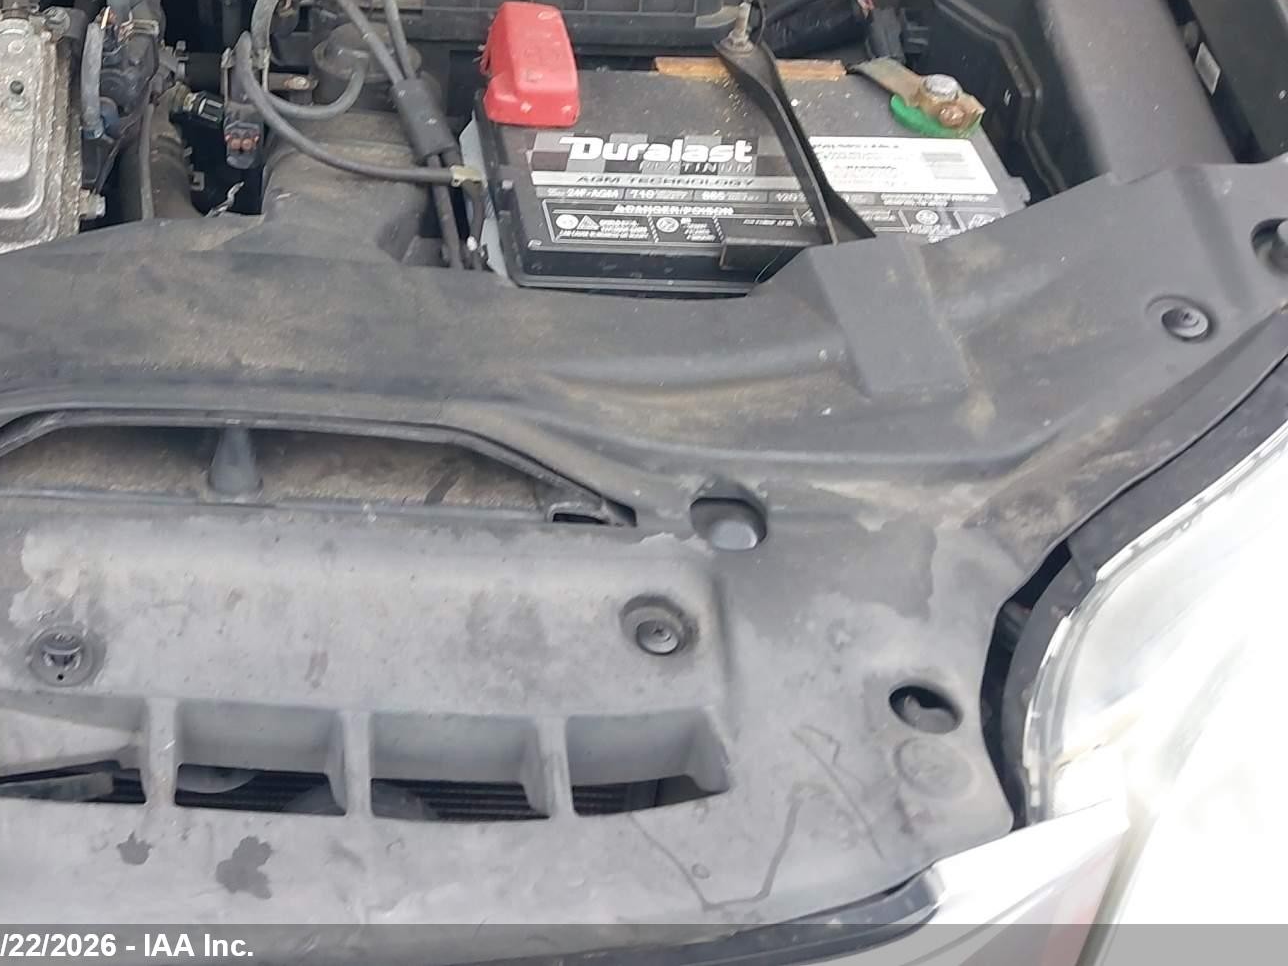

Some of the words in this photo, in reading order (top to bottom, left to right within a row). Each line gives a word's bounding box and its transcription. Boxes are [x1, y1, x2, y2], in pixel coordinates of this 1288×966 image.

[559, 136, 753, 163] Duralast
[638, 161, 754, 173] PLATINUM
[576, 175, 622, 184] AGM
[628, 176, 755, 187] TECHNOLOGY
